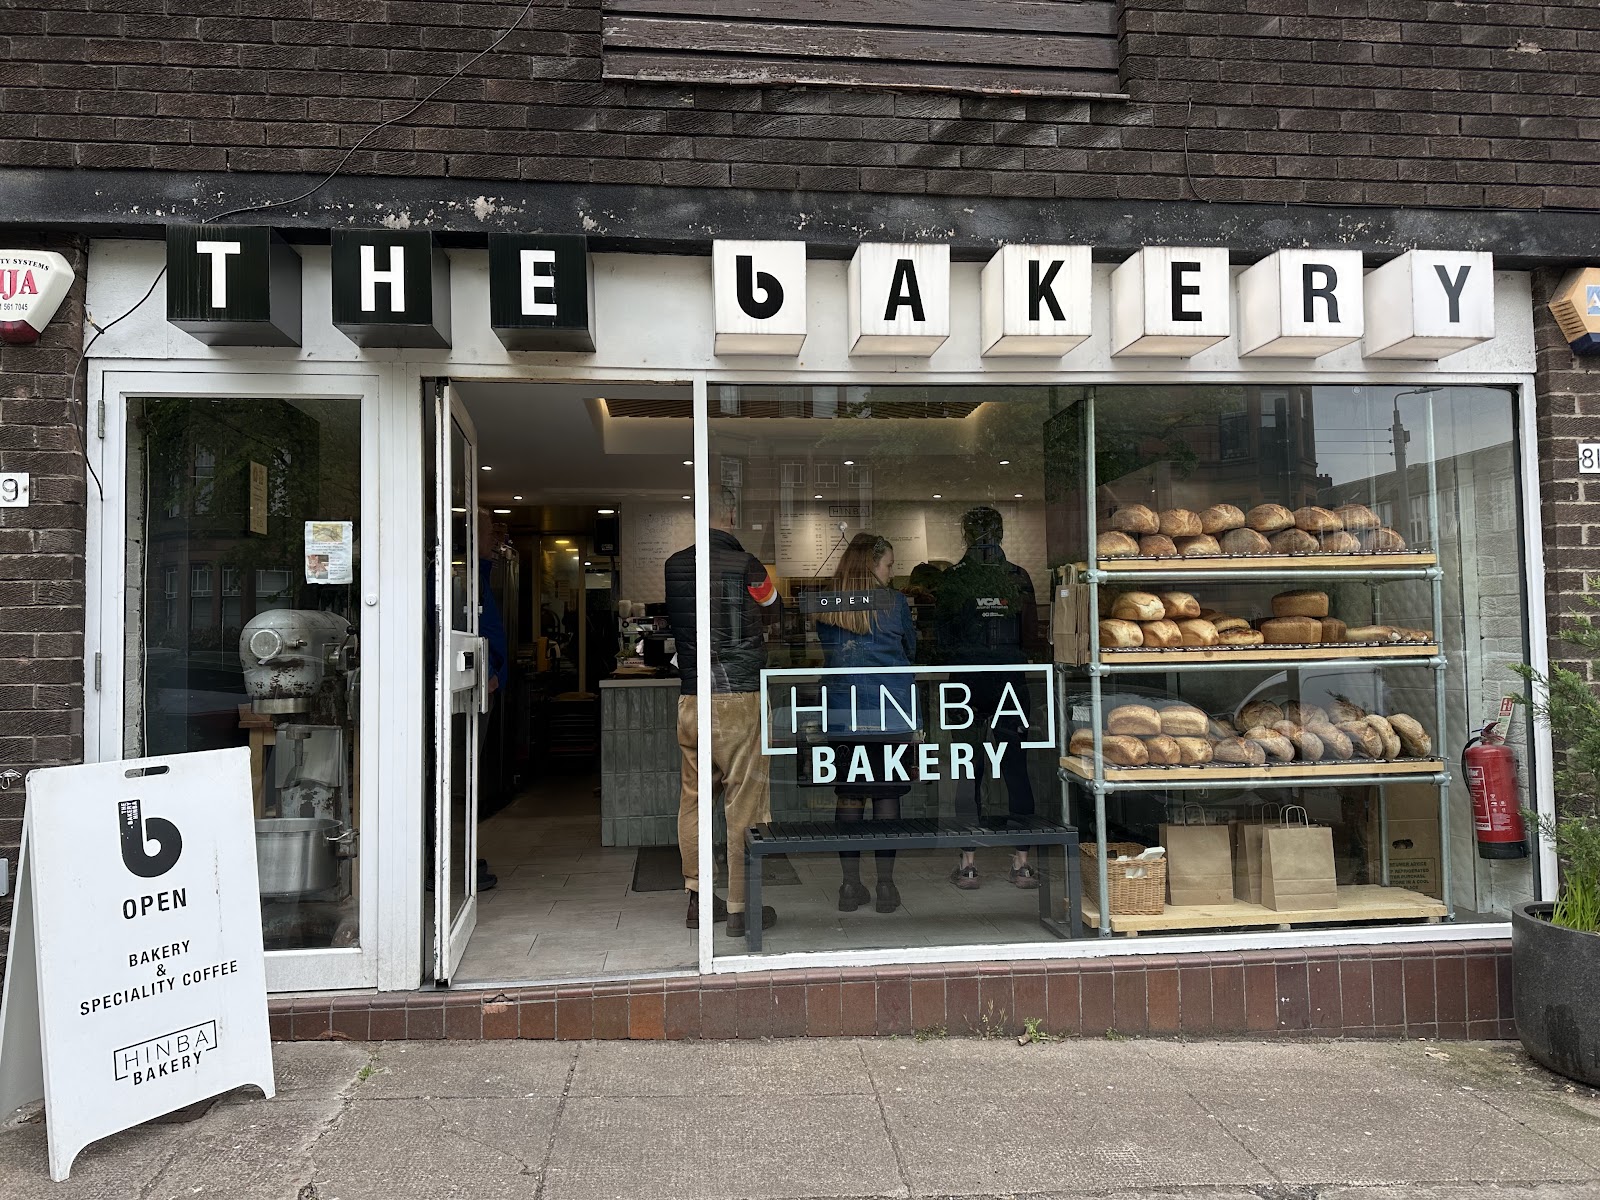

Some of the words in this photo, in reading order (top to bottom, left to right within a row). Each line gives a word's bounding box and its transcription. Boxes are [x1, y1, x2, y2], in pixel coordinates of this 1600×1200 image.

[13, 258, 50, 271] SYSTEMS
[197, 241, 557, 316] THE
[820, 596, 870, 606] OPEN
[976, 598, 1001, 606] VCA
[790, 682, 1029, 734] HINBA
[812, 742, 1008, 783] BAKERY
[122, 887, 187, 920] OPEN
[129, 940, 190, 968] BAKERY
[156, 963, 167, 977] &
[79, 977, 176, 1016] SPECIALITY
[182, 960, 238, 987] COFFEE
[124, 1029, 209, 1071] HINBA
[133, 1051, 202, 1086] BAKERY
